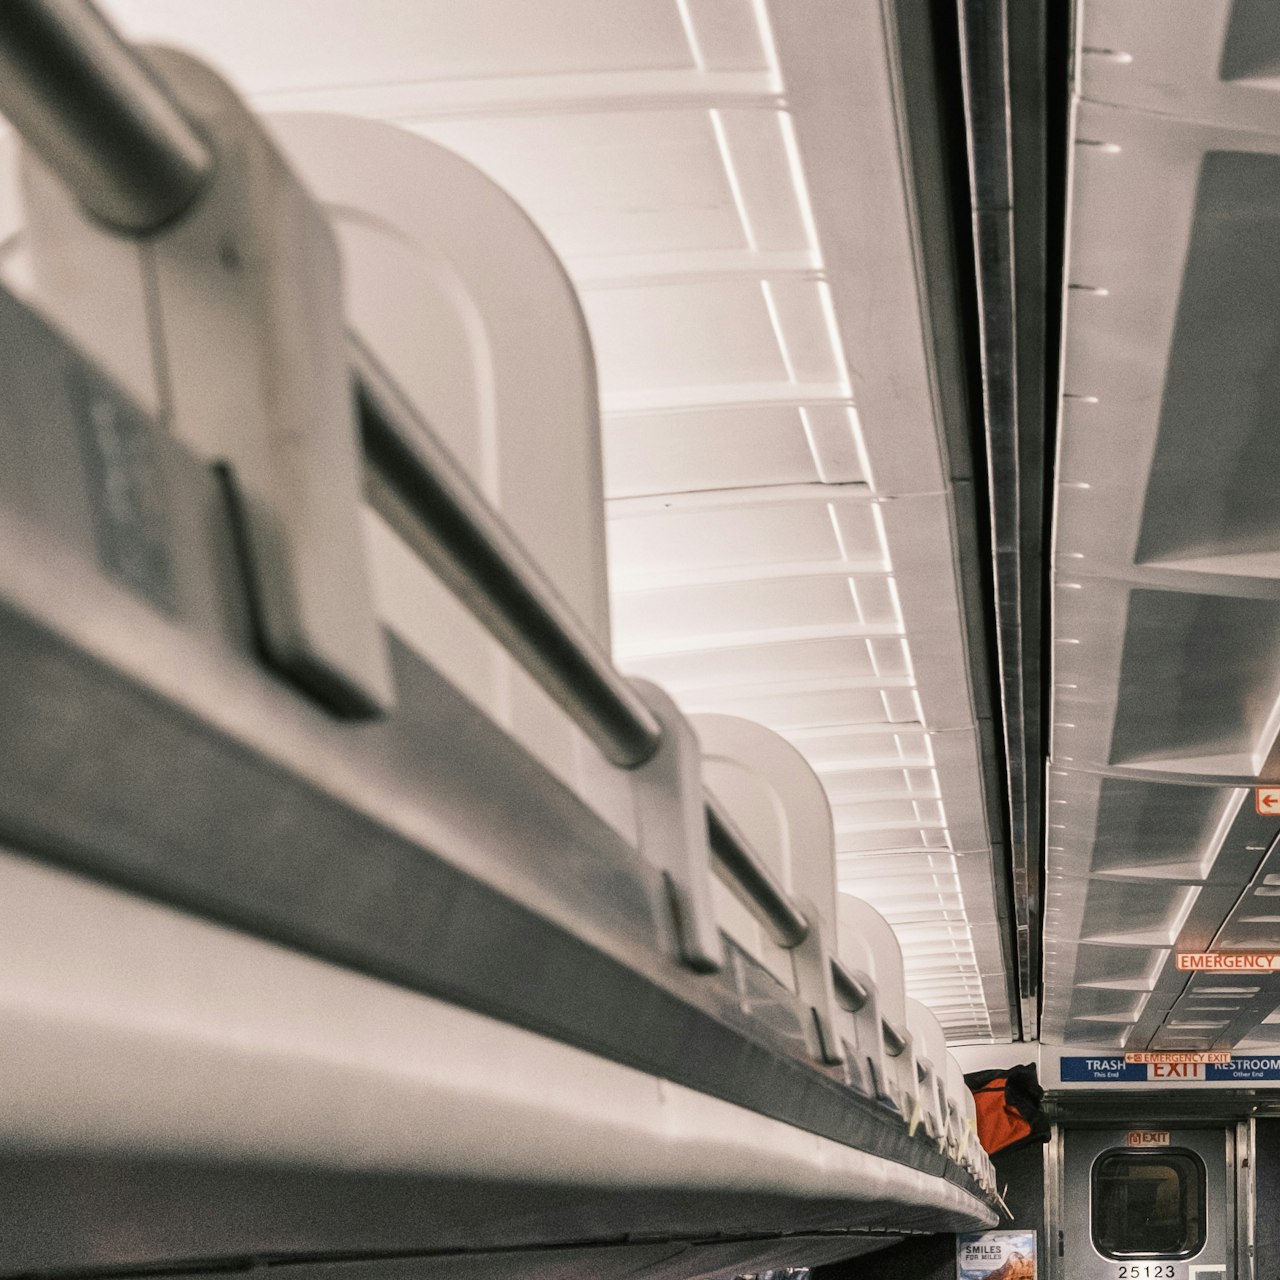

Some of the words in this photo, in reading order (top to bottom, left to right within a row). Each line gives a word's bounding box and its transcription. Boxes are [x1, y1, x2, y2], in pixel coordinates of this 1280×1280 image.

[1181, 955, 1274, 968] EMERGENCY
[1144, 1054, 1206, 1063] EMERGENCY
[1207, 1054, 1229, 1063] EXIT
[1086, 1060, 1126, 1071] TRASH
[1153, 1062, 1199, 1078] EXIT
[1142, 1132, 1168, 1143] EXIT
[965, 1245, 1002, 1254] SMILES
[1118, 1265, 1175, 1279] 25123
